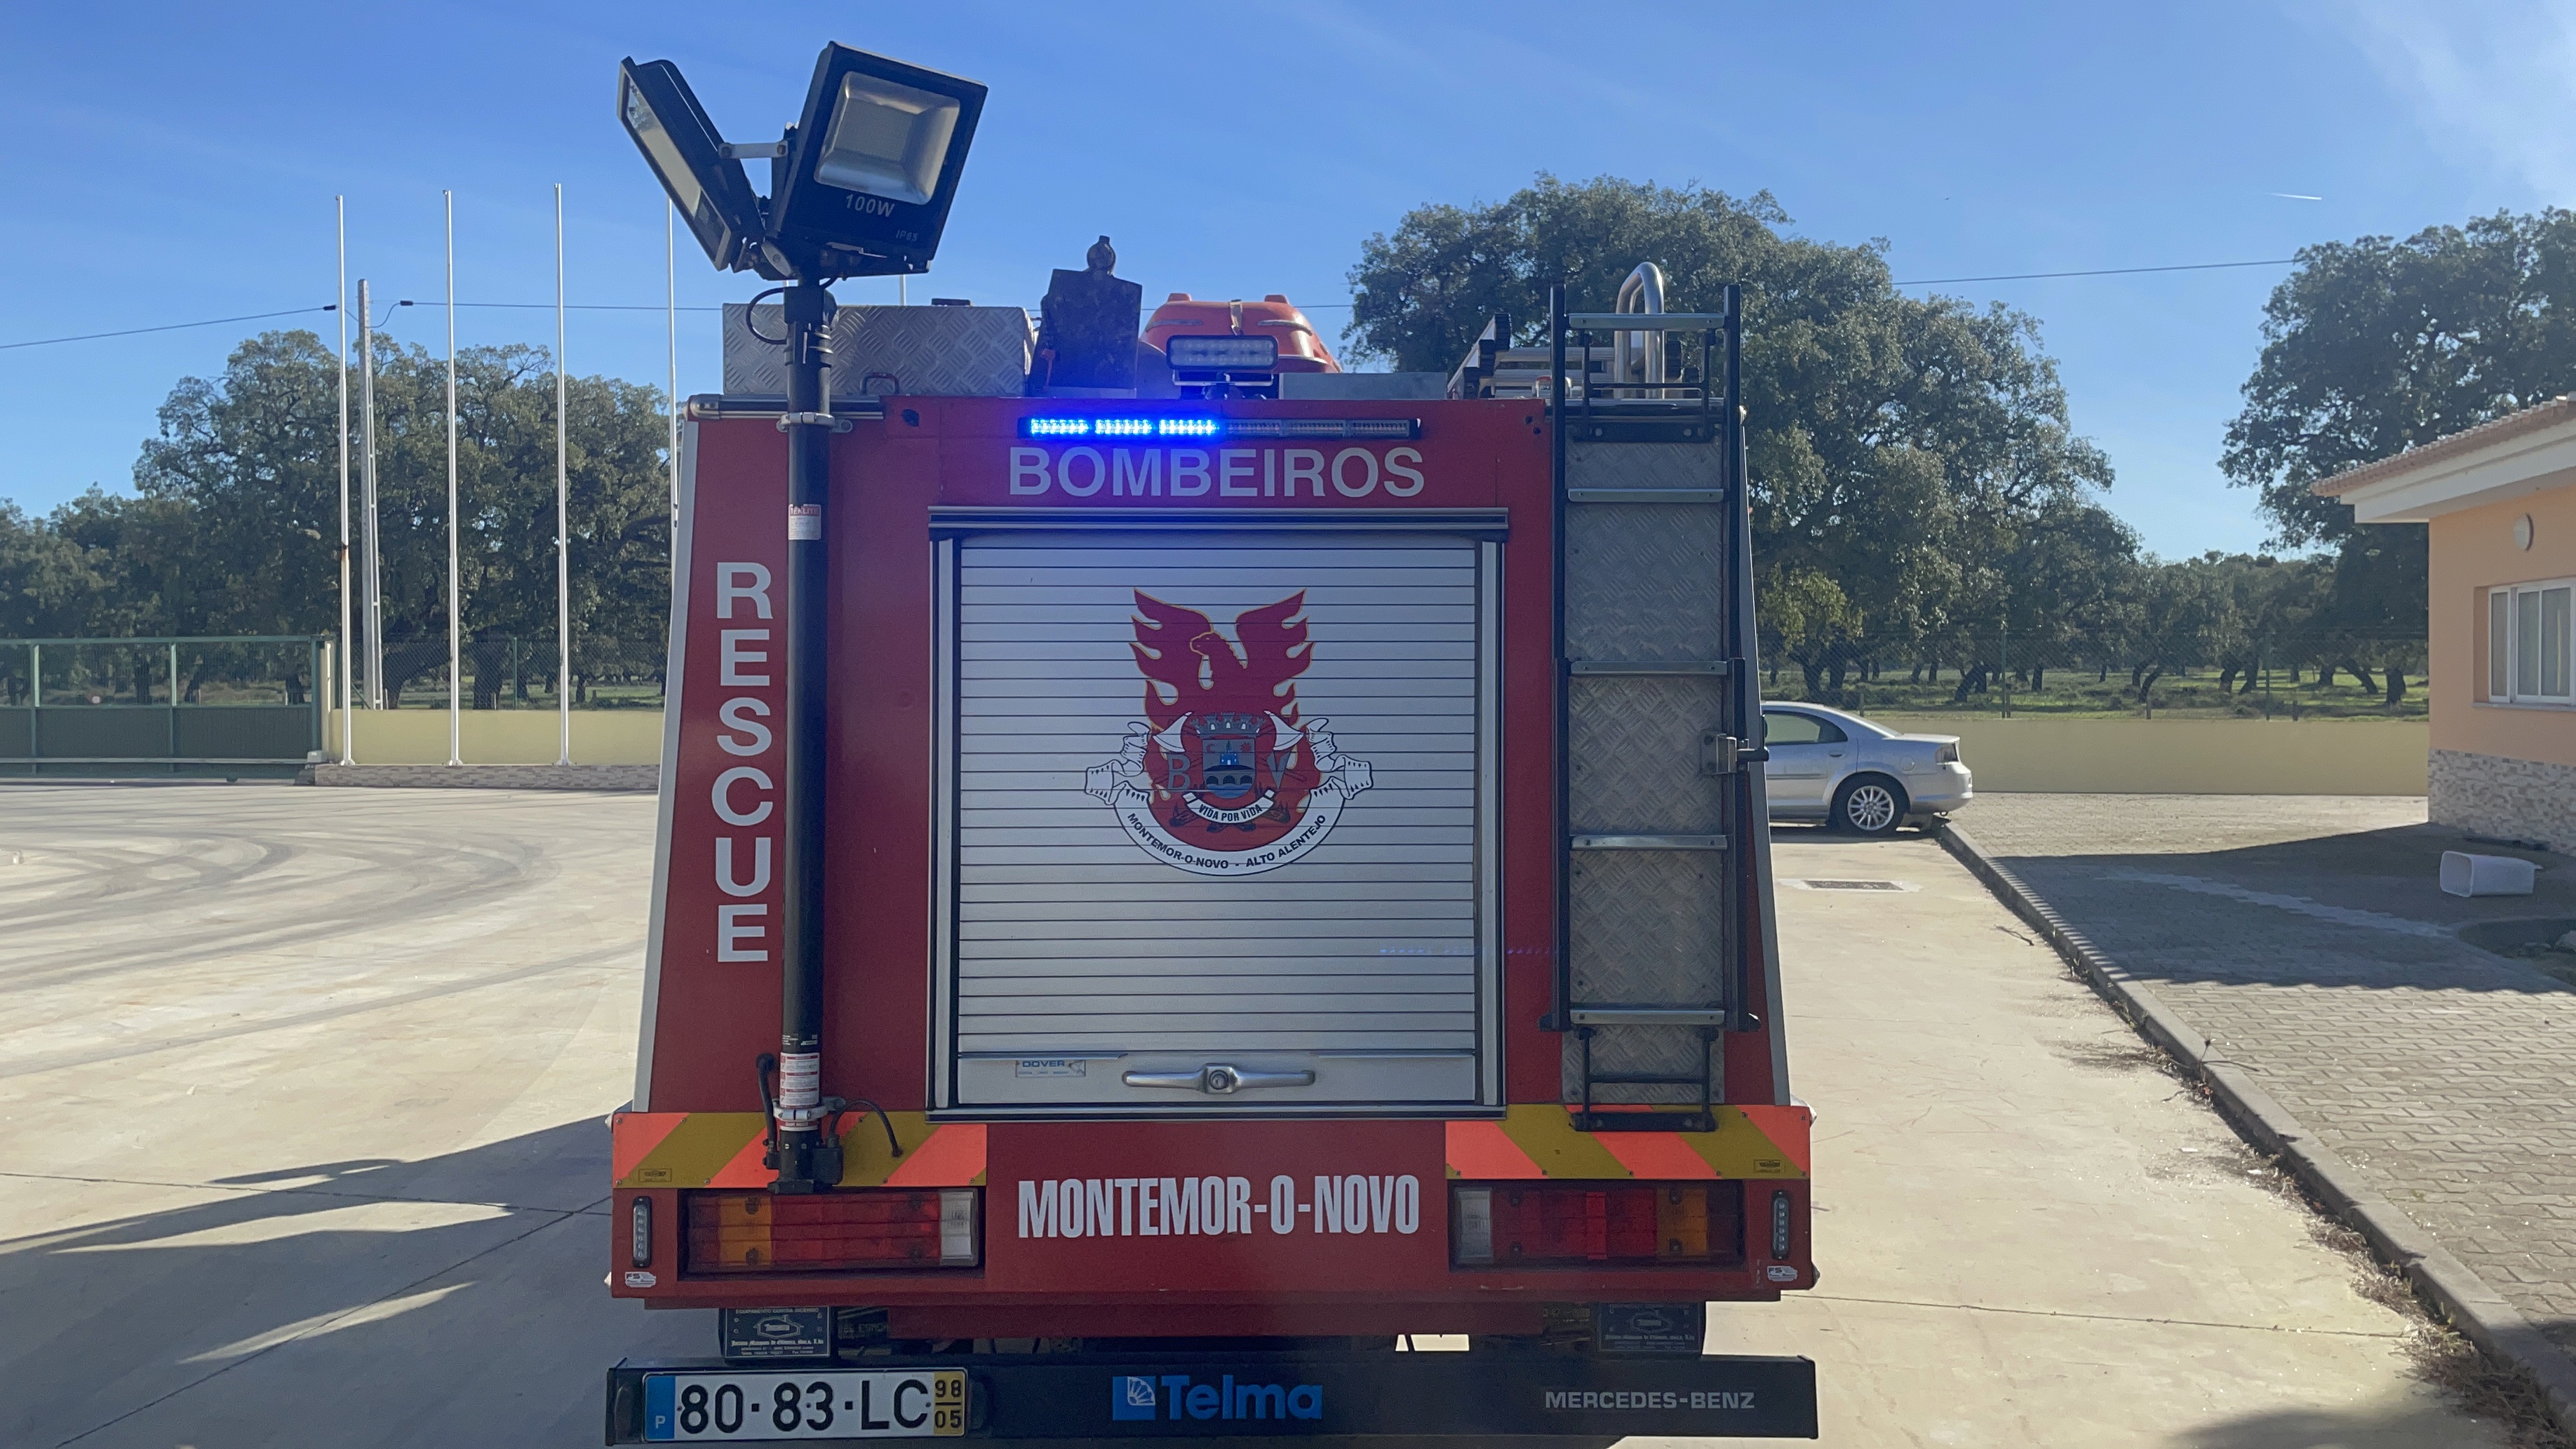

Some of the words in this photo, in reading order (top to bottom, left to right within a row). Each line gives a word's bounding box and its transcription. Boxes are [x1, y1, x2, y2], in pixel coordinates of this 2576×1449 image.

[846, 194, 895, 217] 100W
[1009, 447, 1425, 498] BOMBEIROS
[711, 562, 774, 962] RESCUE
[1167, 753, 1191, 790] B
[1267, 750, 1292, 789] V
[1199, 803, 1219, 821] VIDA
[1221, 809, 1240, 822] POR
[1240, 804, 1263, 820] VIDA
[1127, 812, 1229, 870] MONTEMOR-O-NOVO
[1246, 851, 1275, 868] ALTO
[1277, 814, 1327, 859] ALENTEJO
[1018, 1175, 1420, 1239] MONTEMOR-O-NOVO
[934, 1379, 962, 1399] 98
[1162, 1375, 1323, 1421] Telma
[1545, 1391, 1755, 1410] MERCEDES-BENZ
[655, 1415, 666, 1429] P
[934, 1410, 962, 1429] 05
